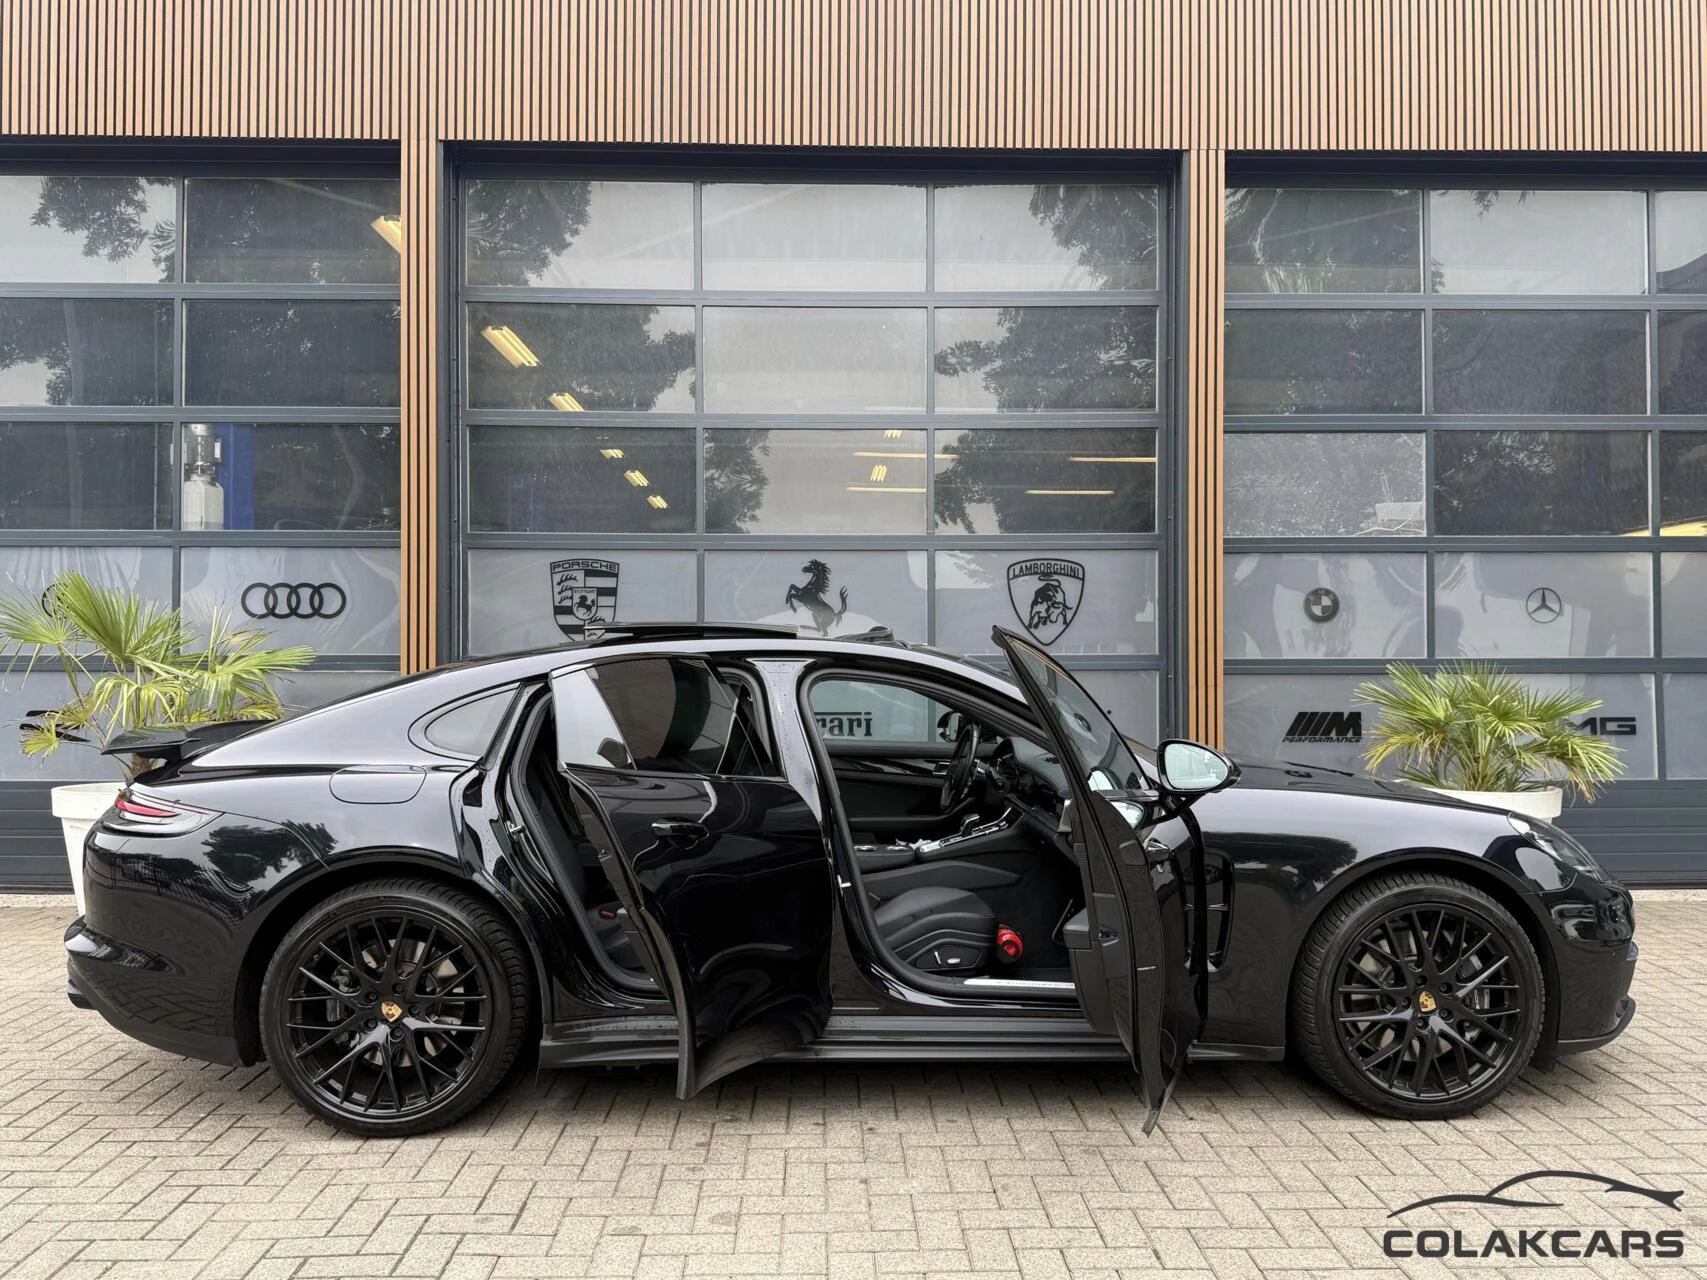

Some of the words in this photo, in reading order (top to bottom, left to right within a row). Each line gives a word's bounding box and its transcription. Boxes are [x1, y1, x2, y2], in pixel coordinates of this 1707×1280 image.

[552, 561, 617, 572] PORSCHE
[1012, 562, 1080, 578] LAMBORGHINI
[1562, 716, 1637, 736] MG
